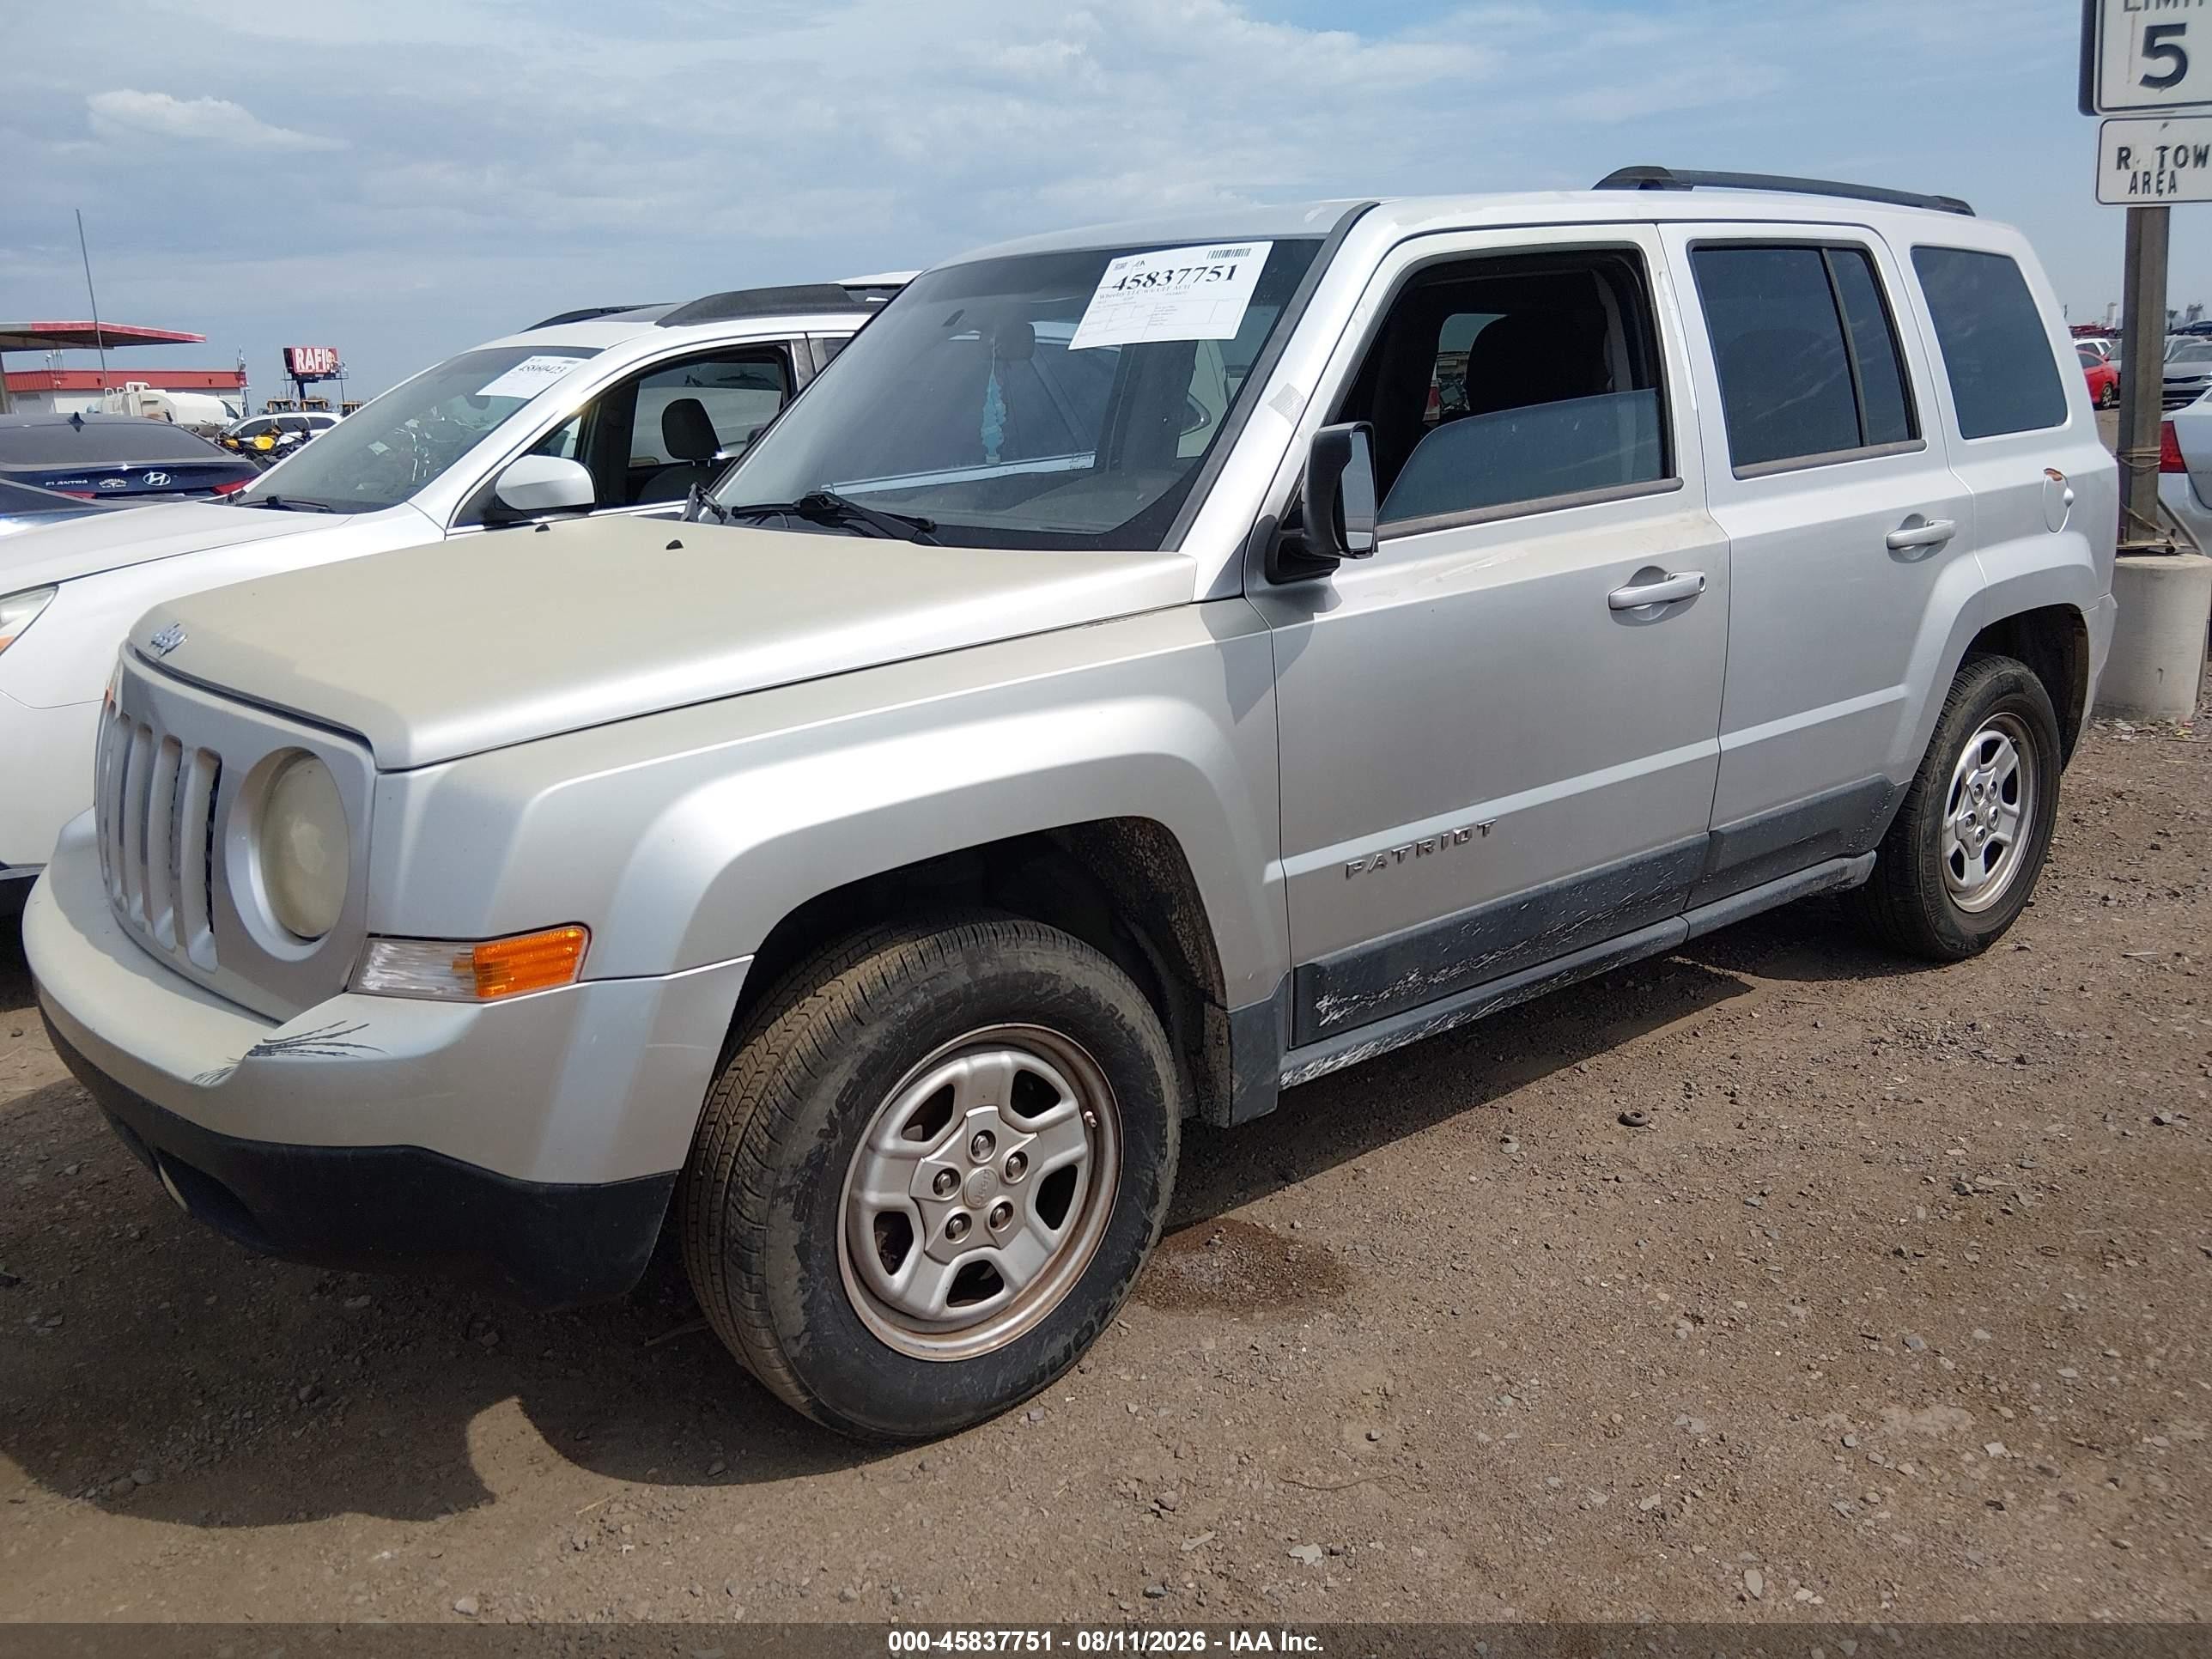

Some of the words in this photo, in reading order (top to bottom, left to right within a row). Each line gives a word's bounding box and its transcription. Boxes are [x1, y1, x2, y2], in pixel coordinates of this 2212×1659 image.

[2138, 22, 2188, 89] 5
[2154, 143, 2210, 170] TOW
[2128, 170, 2178, 196] AREA
[1111, 264, 1239, 292] 45837751
[1345, 818, 1498, 879] PATRIOT
